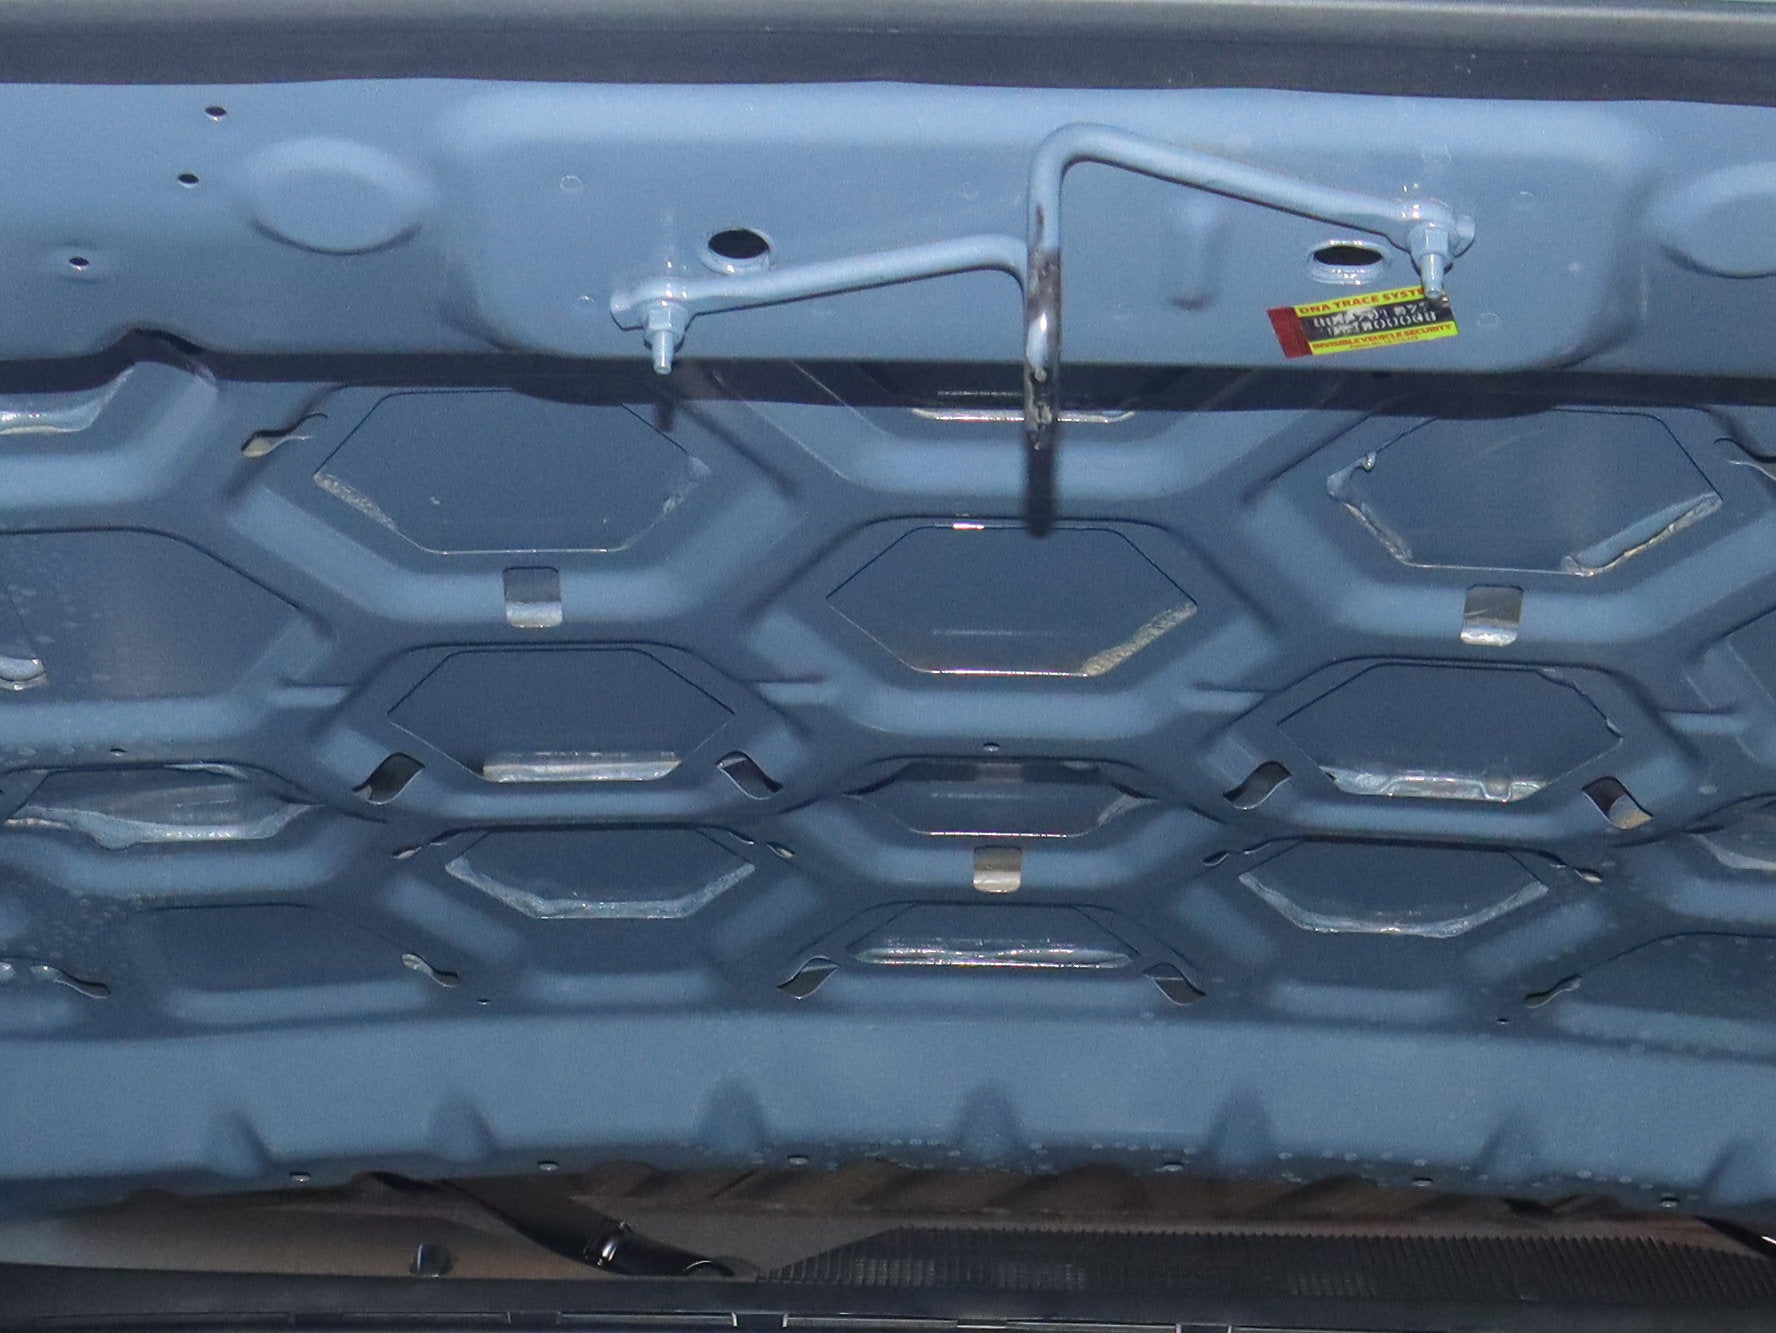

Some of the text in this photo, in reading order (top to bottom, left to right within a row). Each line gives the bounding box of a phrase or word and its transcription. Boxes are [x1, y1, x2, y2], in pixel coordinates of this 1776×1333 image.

[1299, 287, 1425, 315] DNA TRACE SYSTE
